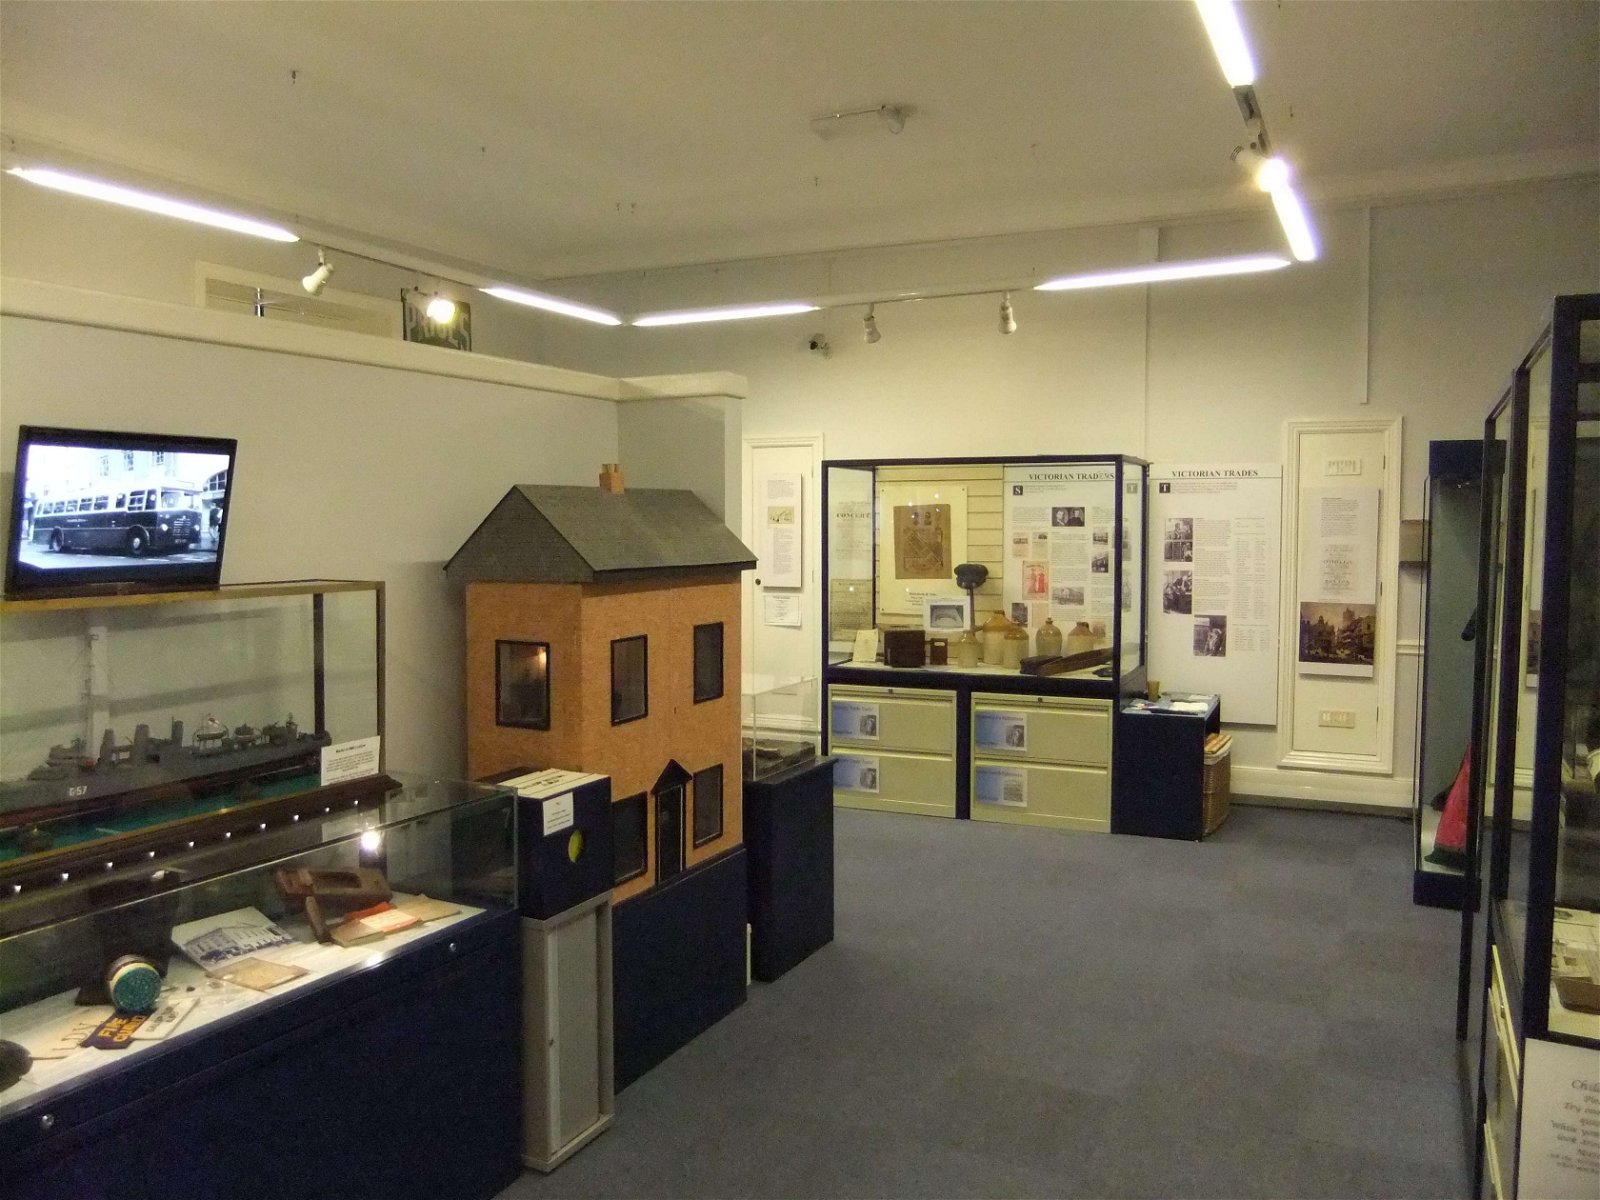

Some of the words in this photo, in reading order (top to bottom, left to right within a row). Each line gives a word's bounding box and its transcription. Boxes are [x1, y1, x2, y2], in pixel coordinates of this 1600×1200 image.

[1028, 473, 1074, 481] VICTORIAN
[1171, 470, 1221, 478] VICTORIAN
[1223, 469, 1259, 477] TRADES
[1161, 484, 1169, 493] T
